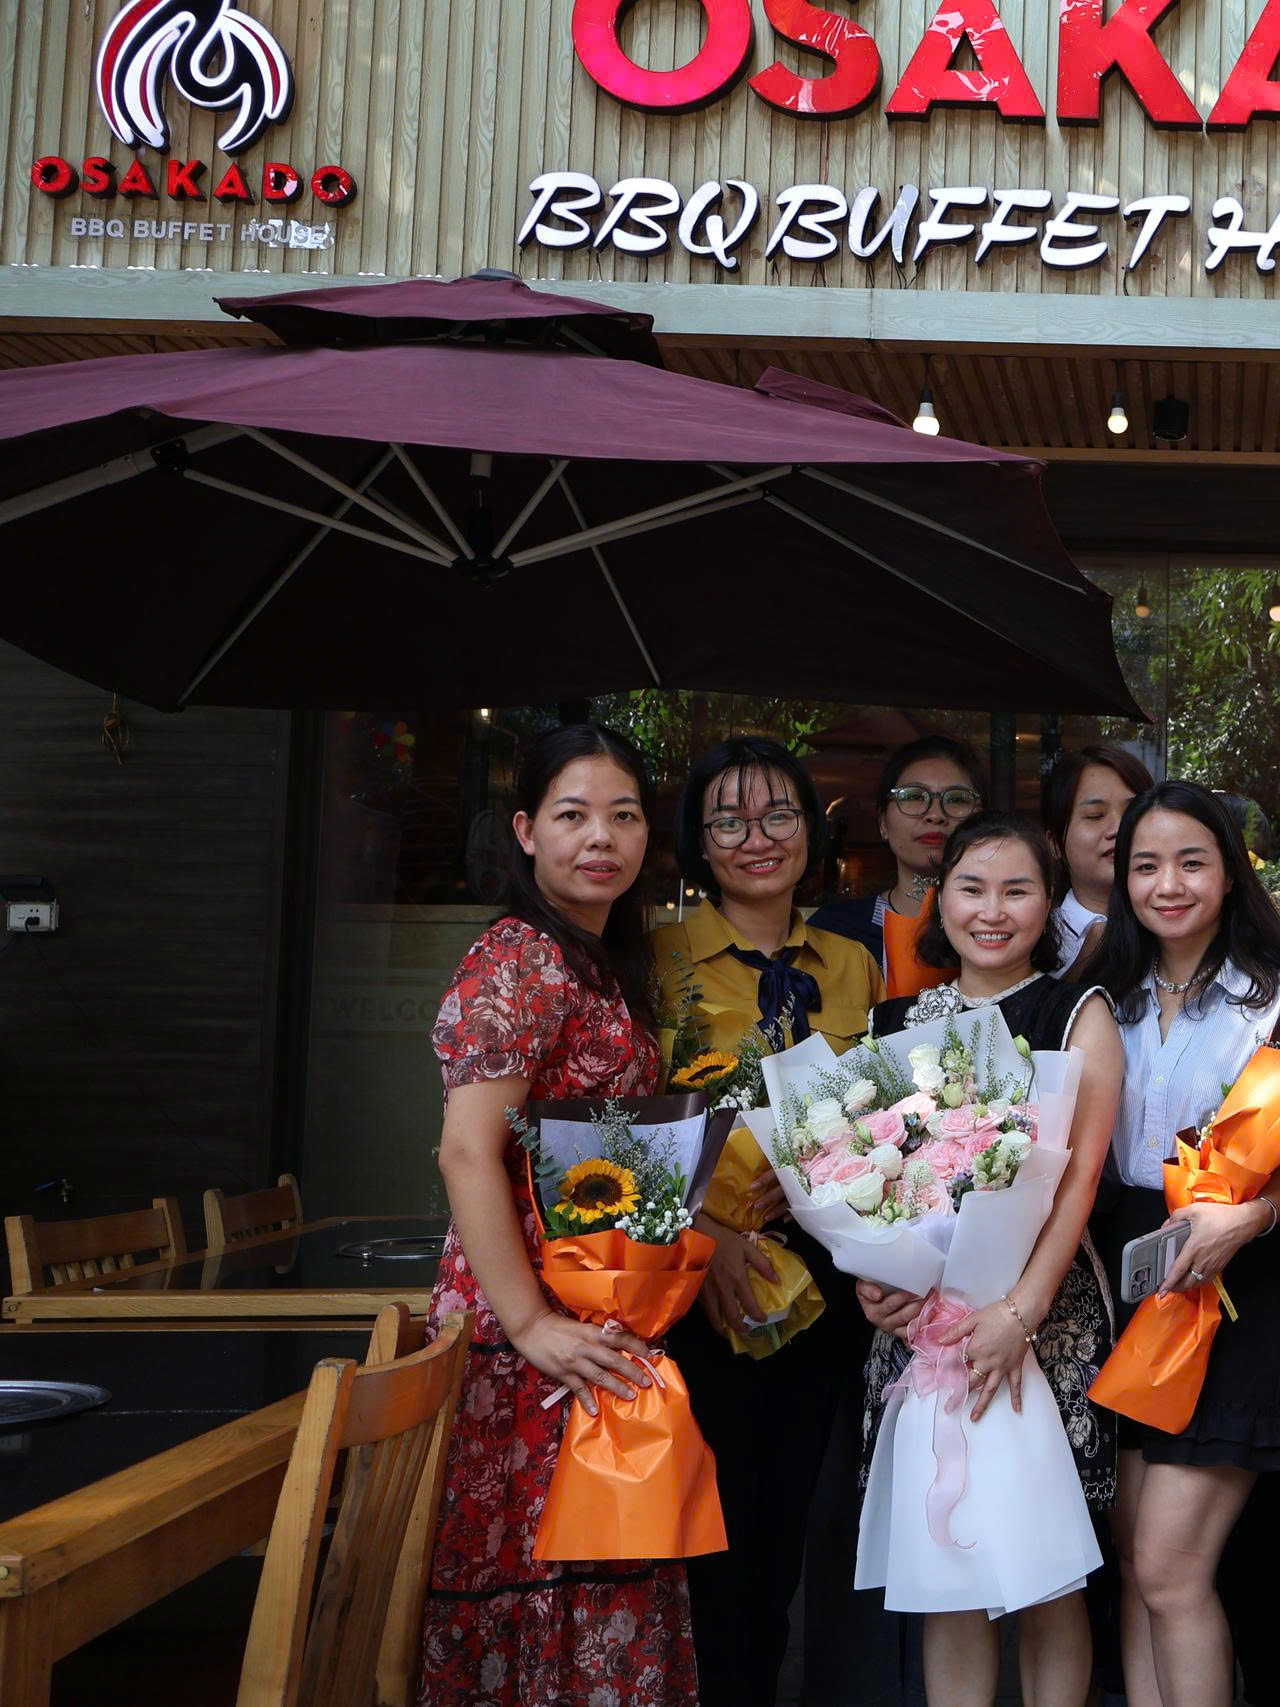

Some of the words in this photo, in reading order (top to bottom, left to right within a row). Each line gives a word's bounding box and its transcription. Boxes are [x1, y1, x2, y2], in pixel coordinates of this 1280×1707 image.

[31, 155, 355, 207] OSAKADO
[71, 217, 125, 239] BBQ
[133, 218, 231, 242] BUFFET
[240, 222, 326, 244] HOUSE
[330, 997, 440, 1022] WELCO
